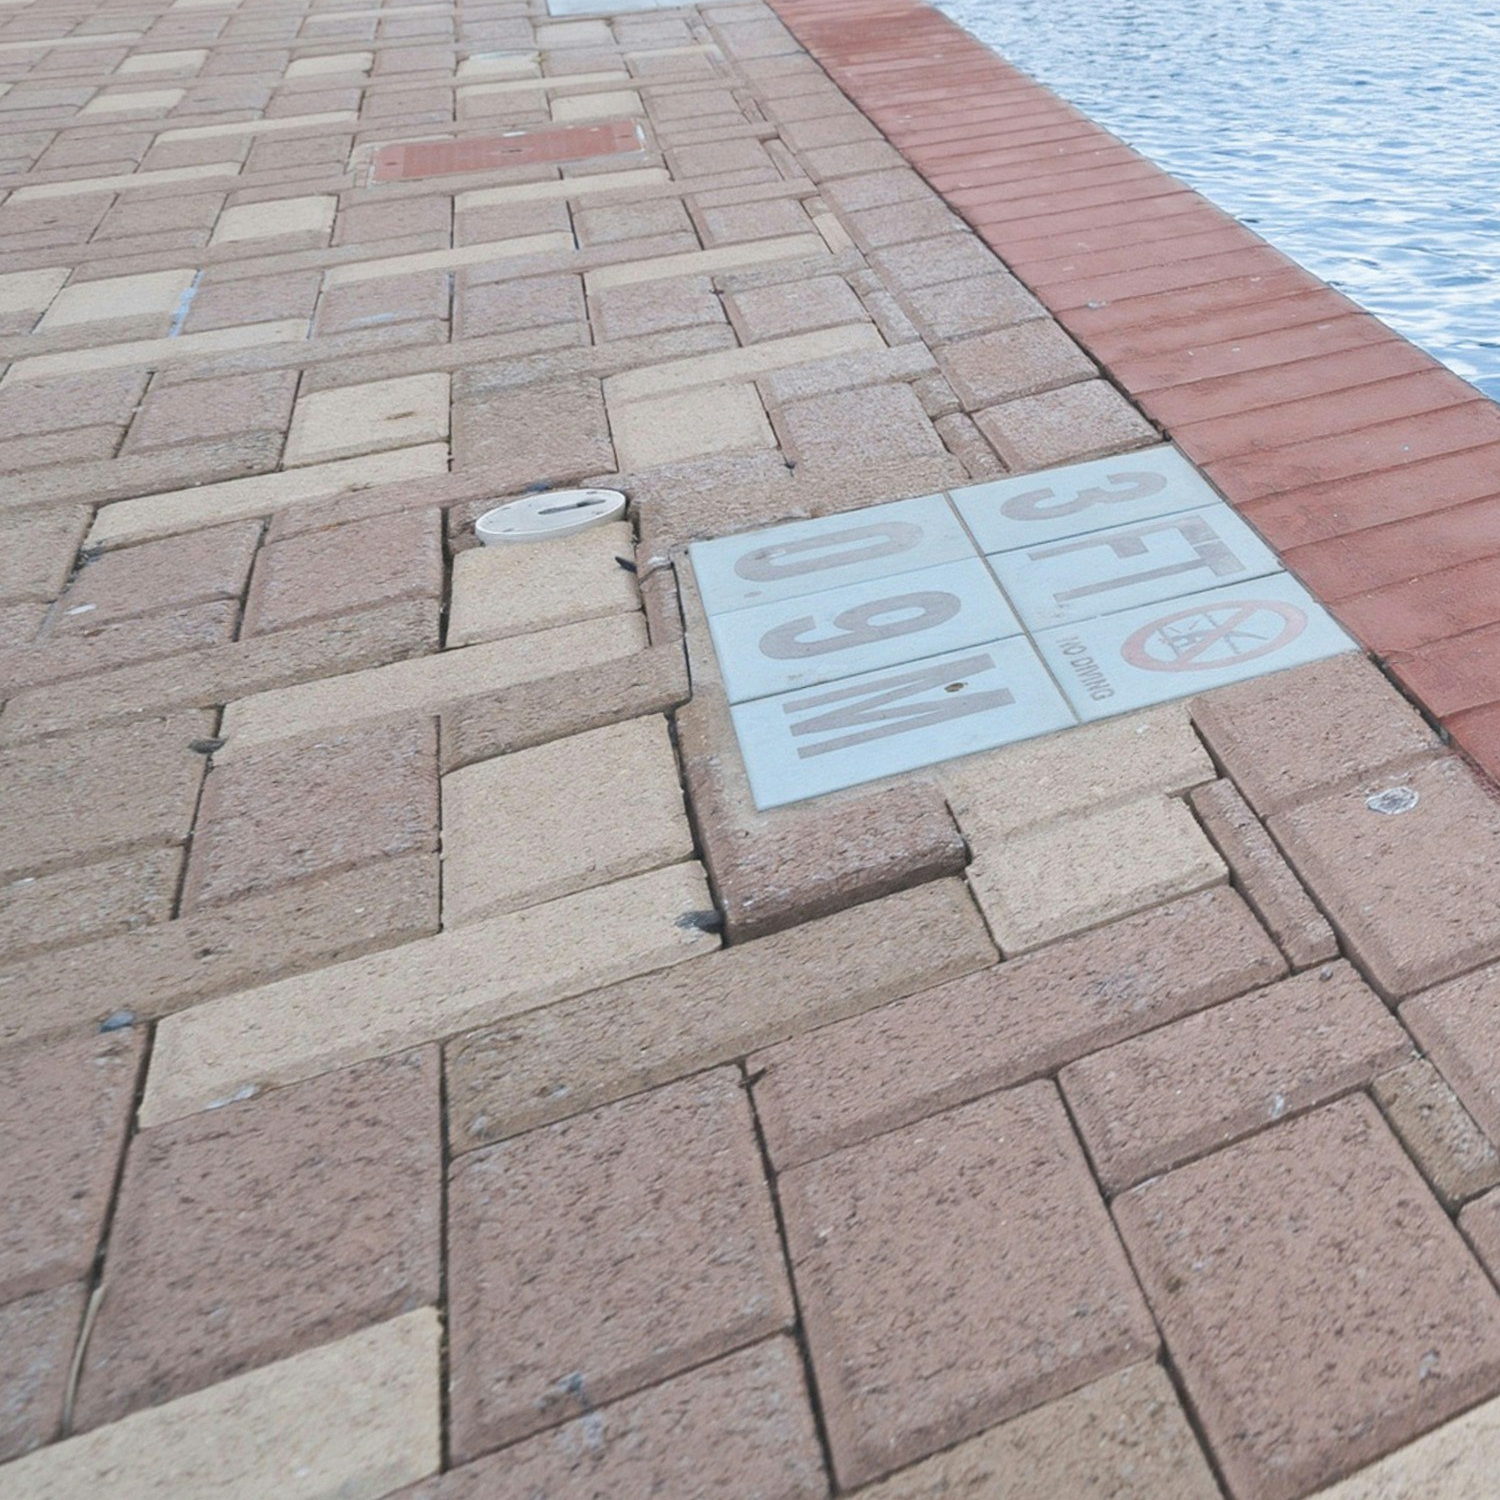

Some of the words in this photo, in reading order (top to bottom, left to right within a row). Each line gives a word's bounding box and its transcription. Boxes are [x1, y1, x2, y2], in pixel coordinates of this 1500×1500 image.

[1000, 470, 1167, 521] 3
[1027, 515, 1246, 608] FT
[1071, 657, 1115, 701] DIVING
